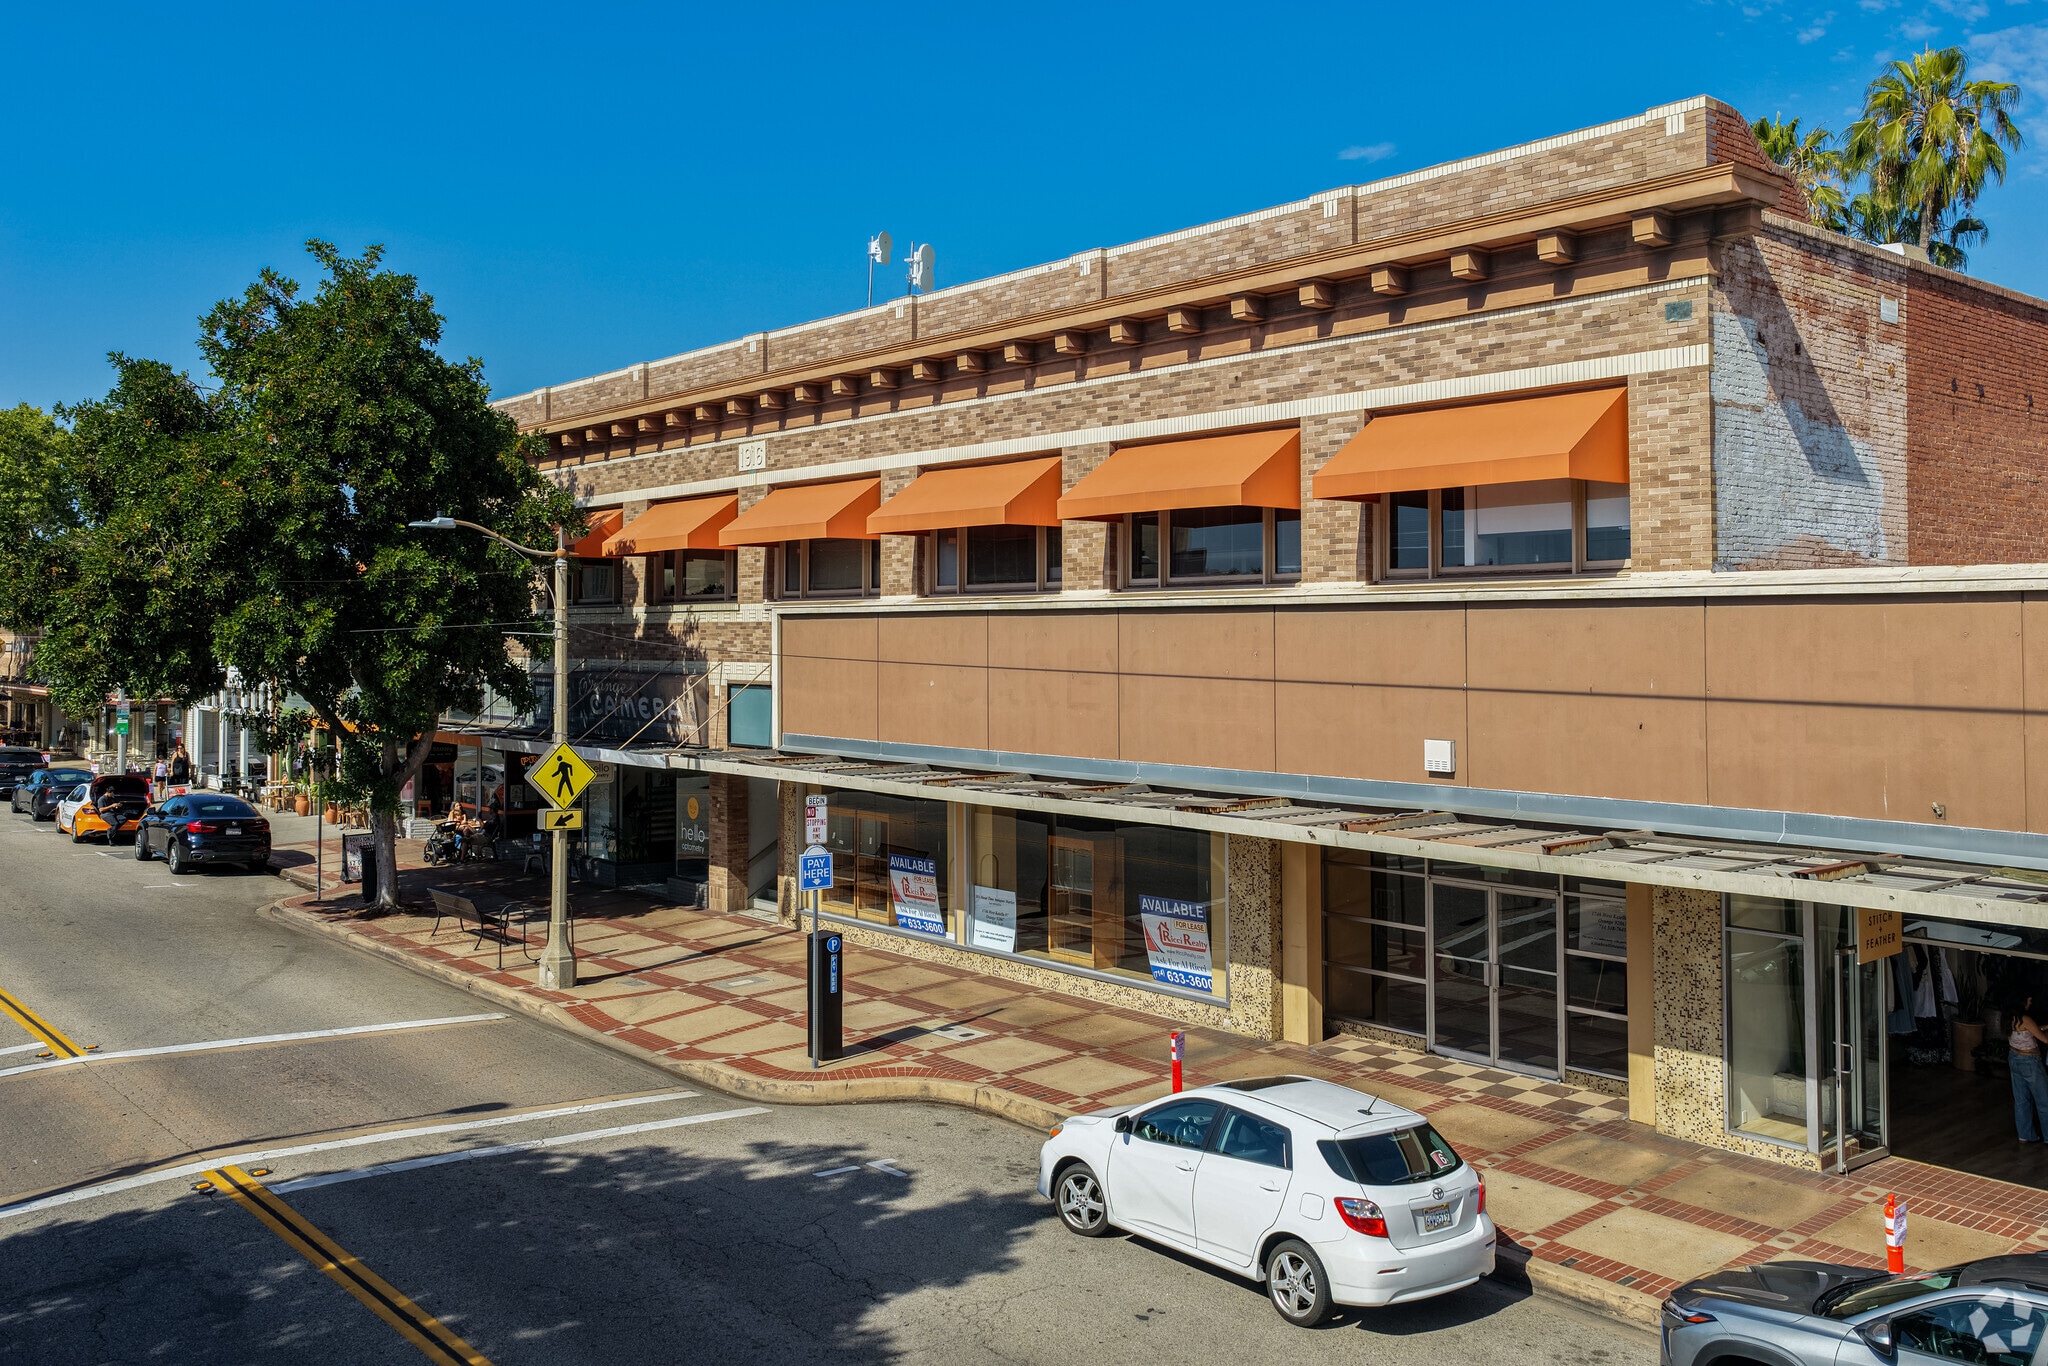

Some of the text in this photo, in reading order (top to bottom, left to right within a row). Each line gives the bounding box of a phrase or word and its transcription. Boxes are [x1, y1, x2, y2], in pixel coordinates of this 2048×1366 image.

[741, 446, 763, 468] 1916
[590, 695, 683, 722] CAMERA
[594, 763, 610, 773] ello
[808, 797, 826, 805] BEGIN
[807, 807, 815, 817] NO
[807, 819, 827, 827] STOPPING
[681, 822, 705, 842] hello
[682, 843, 705, 854] optometry
[807, 858, 826, 869] PAY
[890, 856, 935, 873] AVAILABLE
[804, 868, 830, 879] HERE
[1141, 898, 1204, 918] AVAILABLE
[907, 918, 943, 933] 633-3600
[1869, 912, 1893, 926] STITCH
[1187, 922, 1204, 931] LEASE
[831, 940, 838, 951] P
[1163, 931, 1208, 949] Ricci Realty
[1866, 933, 1896, 949] FEATHER
[1155, 956, 1167, 965] Ask
[1168, 958, 1179, 967] For
[1189, 962, 1207, 972] Ricci
[1153, 969, 1212, 989] (714) 633-3600
